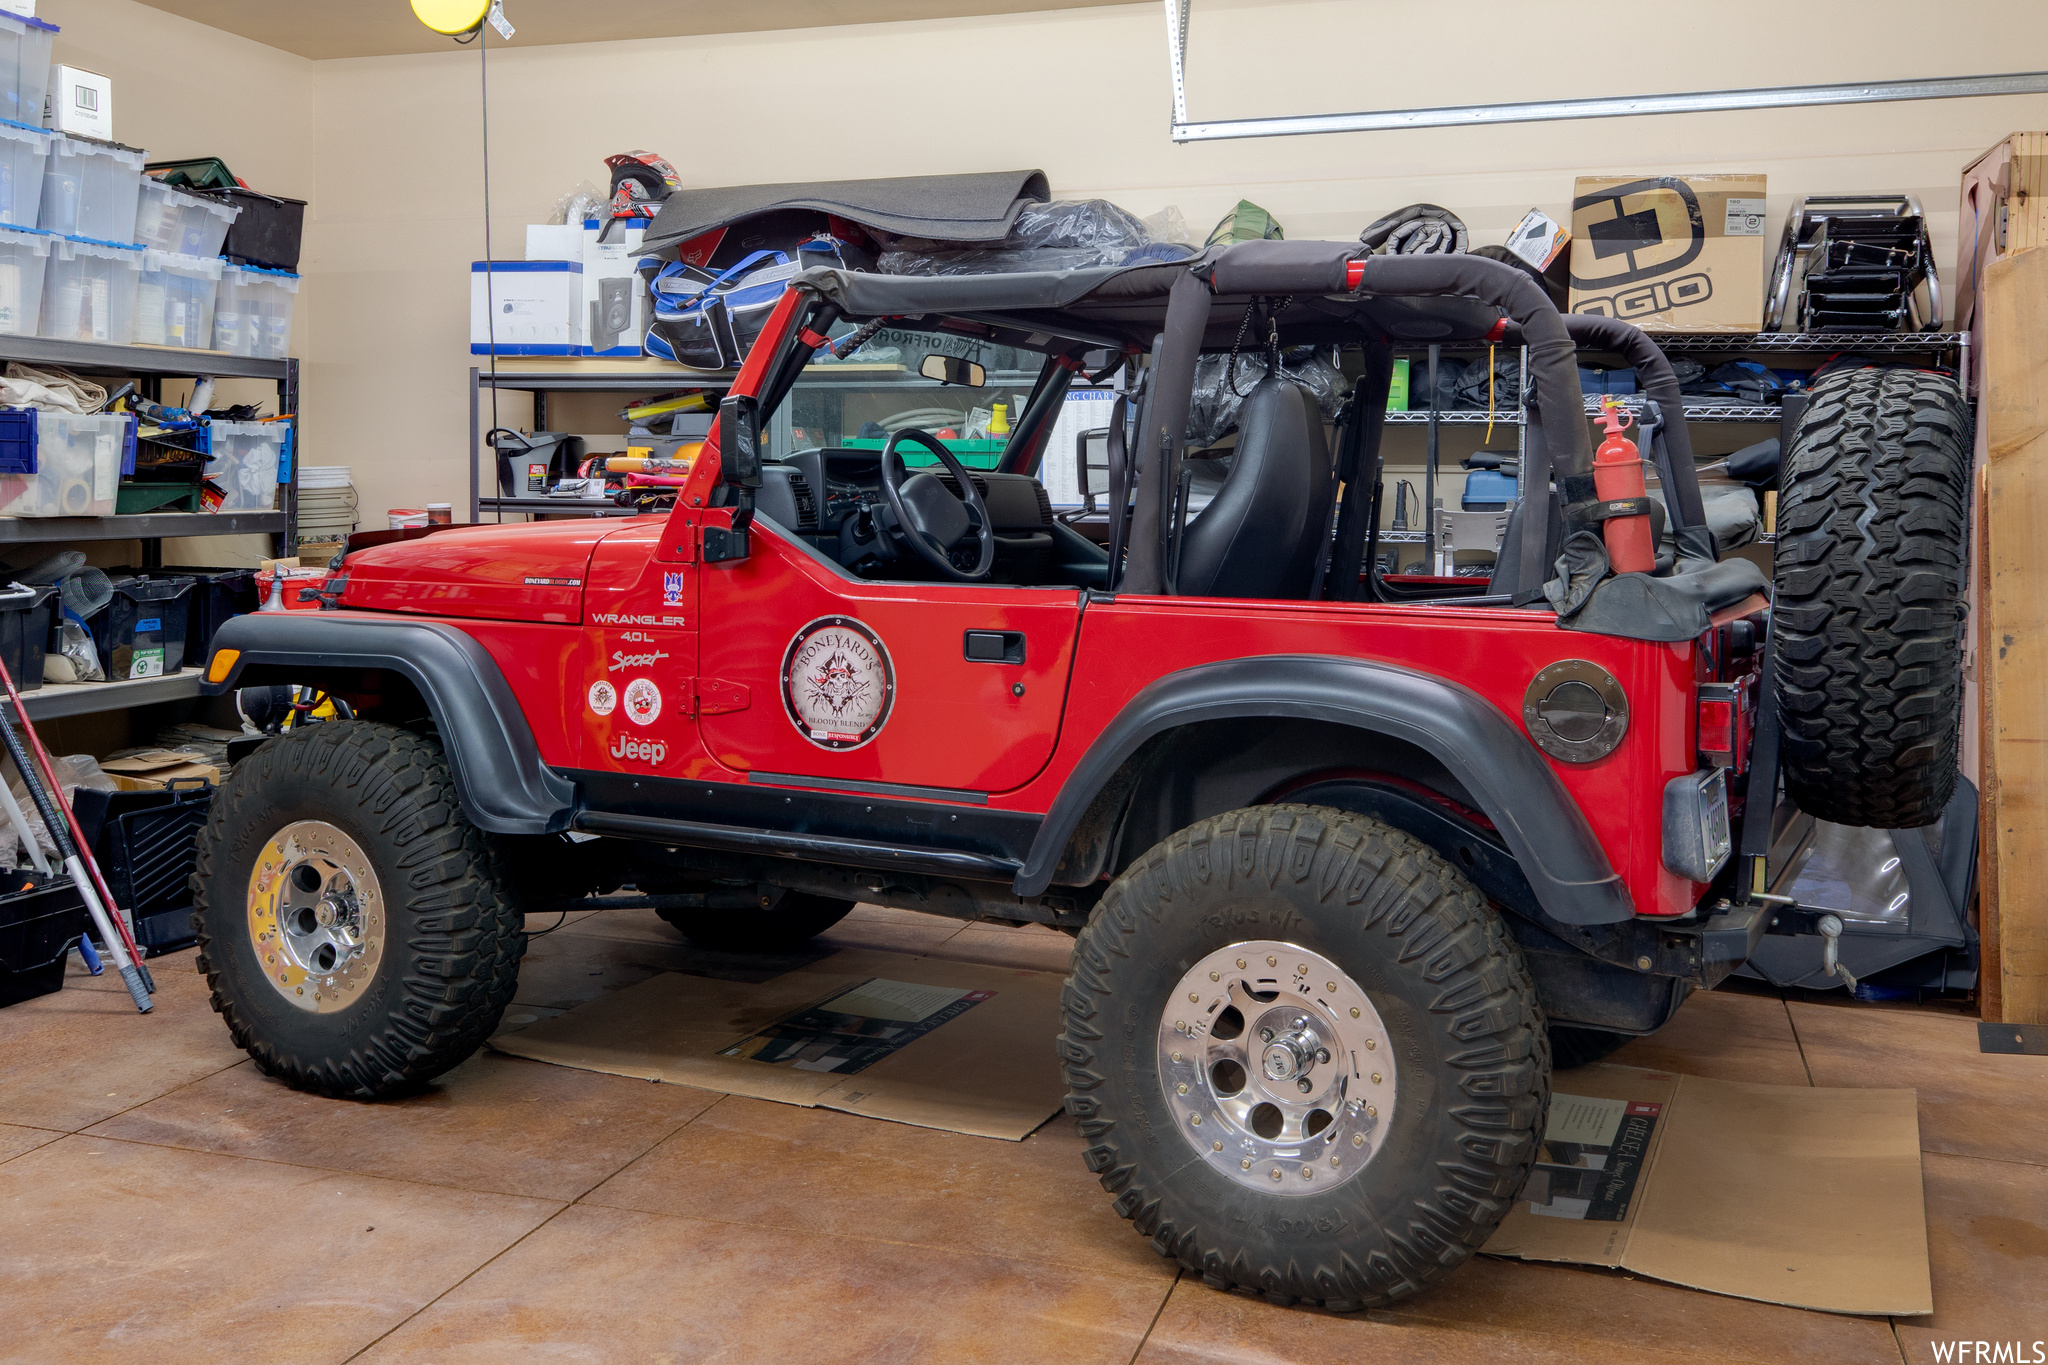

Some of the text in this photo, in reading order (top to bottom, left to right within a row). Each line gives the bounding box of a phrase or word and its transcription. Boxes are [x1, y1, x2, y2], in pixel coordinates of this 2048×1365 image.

[1572, 272, 1713, 320] OGIO
[592, 613, 685, 626] WRANGLER
[800, 634, 876, 671] BONEYARD'S
[808, 717, 866, 728] BLOODY BLEND
[827, 732, 860, 741] RESPONSIBLY
[611, 736, 665, 766] Jeep
[914, 1001, 970, 1032] CHELSEA
[1618, 1117, 1649, 1158] CHELSEA
[1603, 1159, 1632, 1178] Storage
[1604, 1179, 1626, 1202] Ottoman
